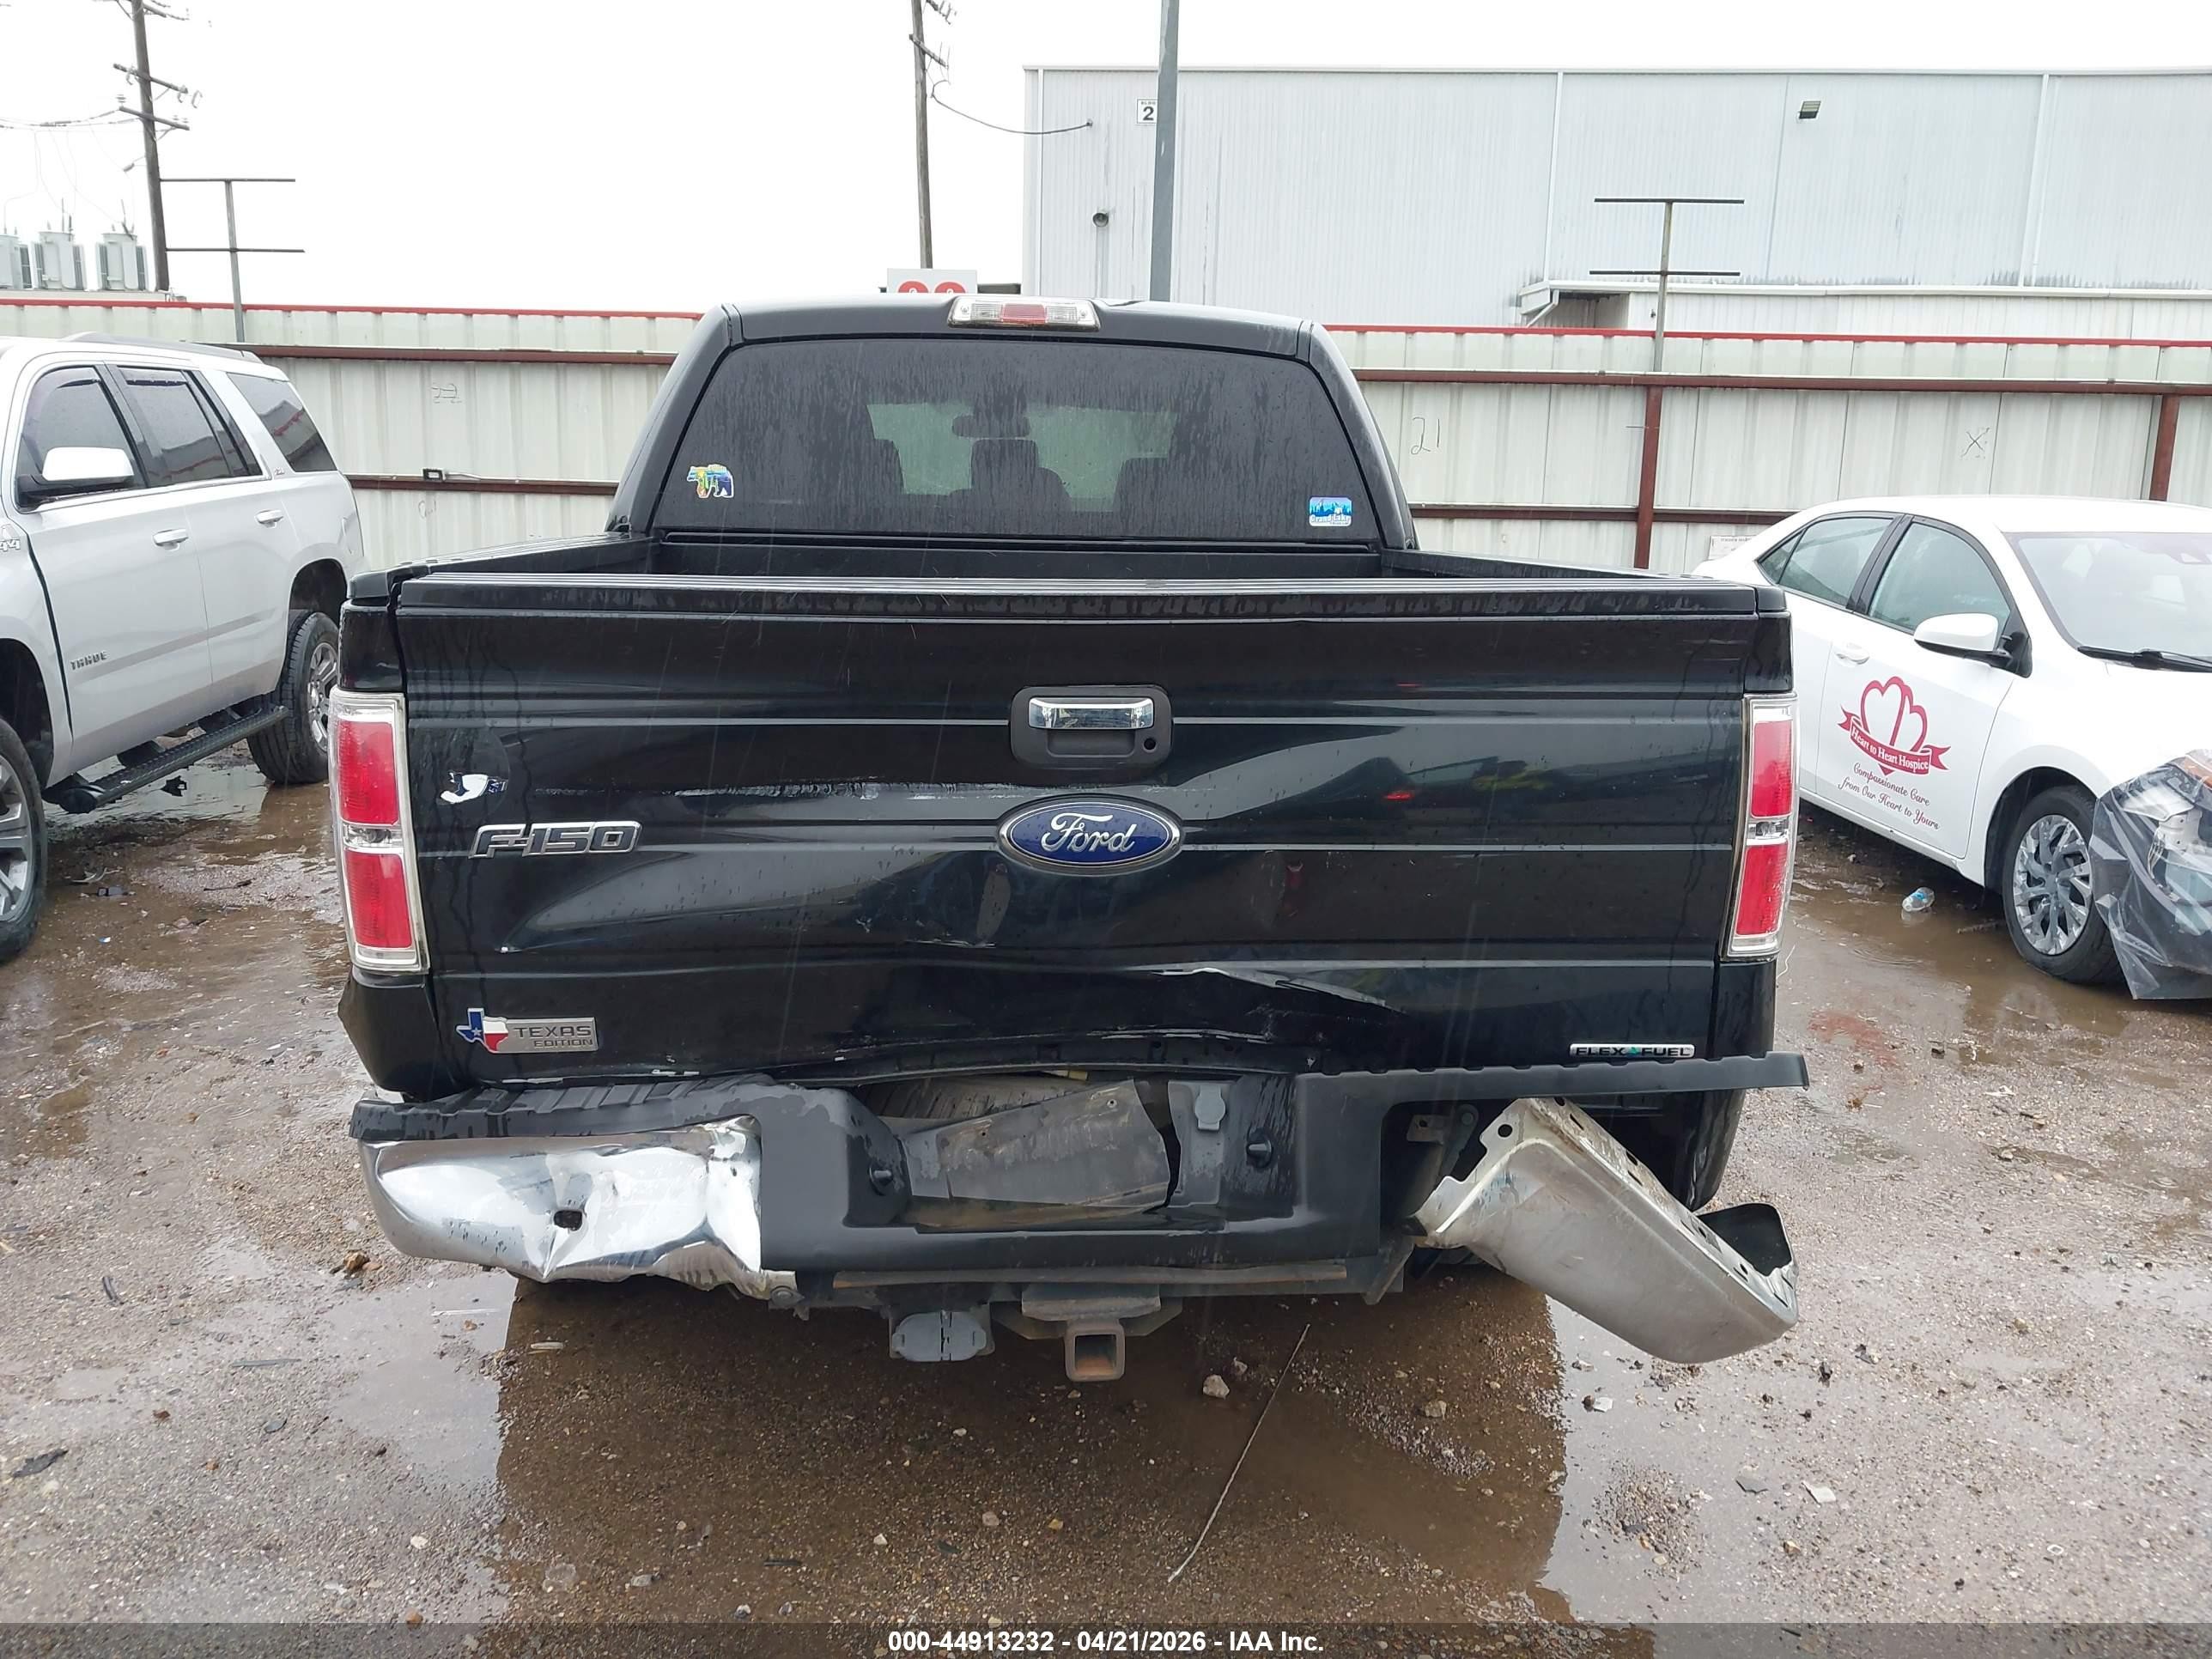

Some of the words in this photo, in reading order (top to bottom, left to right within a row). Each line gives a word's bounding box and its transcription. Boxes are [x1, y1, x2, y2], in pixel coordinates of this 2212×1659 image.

[1142, 106, 1154, 121] 2
[70, 651, 108, 671] TAHOE
[1851, 726, 1870, 749] Heart
[1869, 745, 1877, 755] to
[1878, 746, 1899, 764] Heart
[1899, 754, 1929, 773] Hospice
[1853, 763, 1908, 797] Compassionate
[1910, 788, 1929, 806] Care
[1838, 776, 1860, 793] from
[1862, 785, 1876, 800] Our
[1878, 793, 1902, 812] Heart
[1905, 807, 1912, 817] to
[1913, 809, 1941, 830] Yours
[468, 821, 642, 859] F-150
[1041, 812, 1137, 852] Ford
[514, 1026, 592, 1038] TEXAS
[534, 1038, 592, 1047] EDITION
[1576, 1047, 1625, 1056] FLEX
[1641, 1047, 1691, 1056] FUEL
